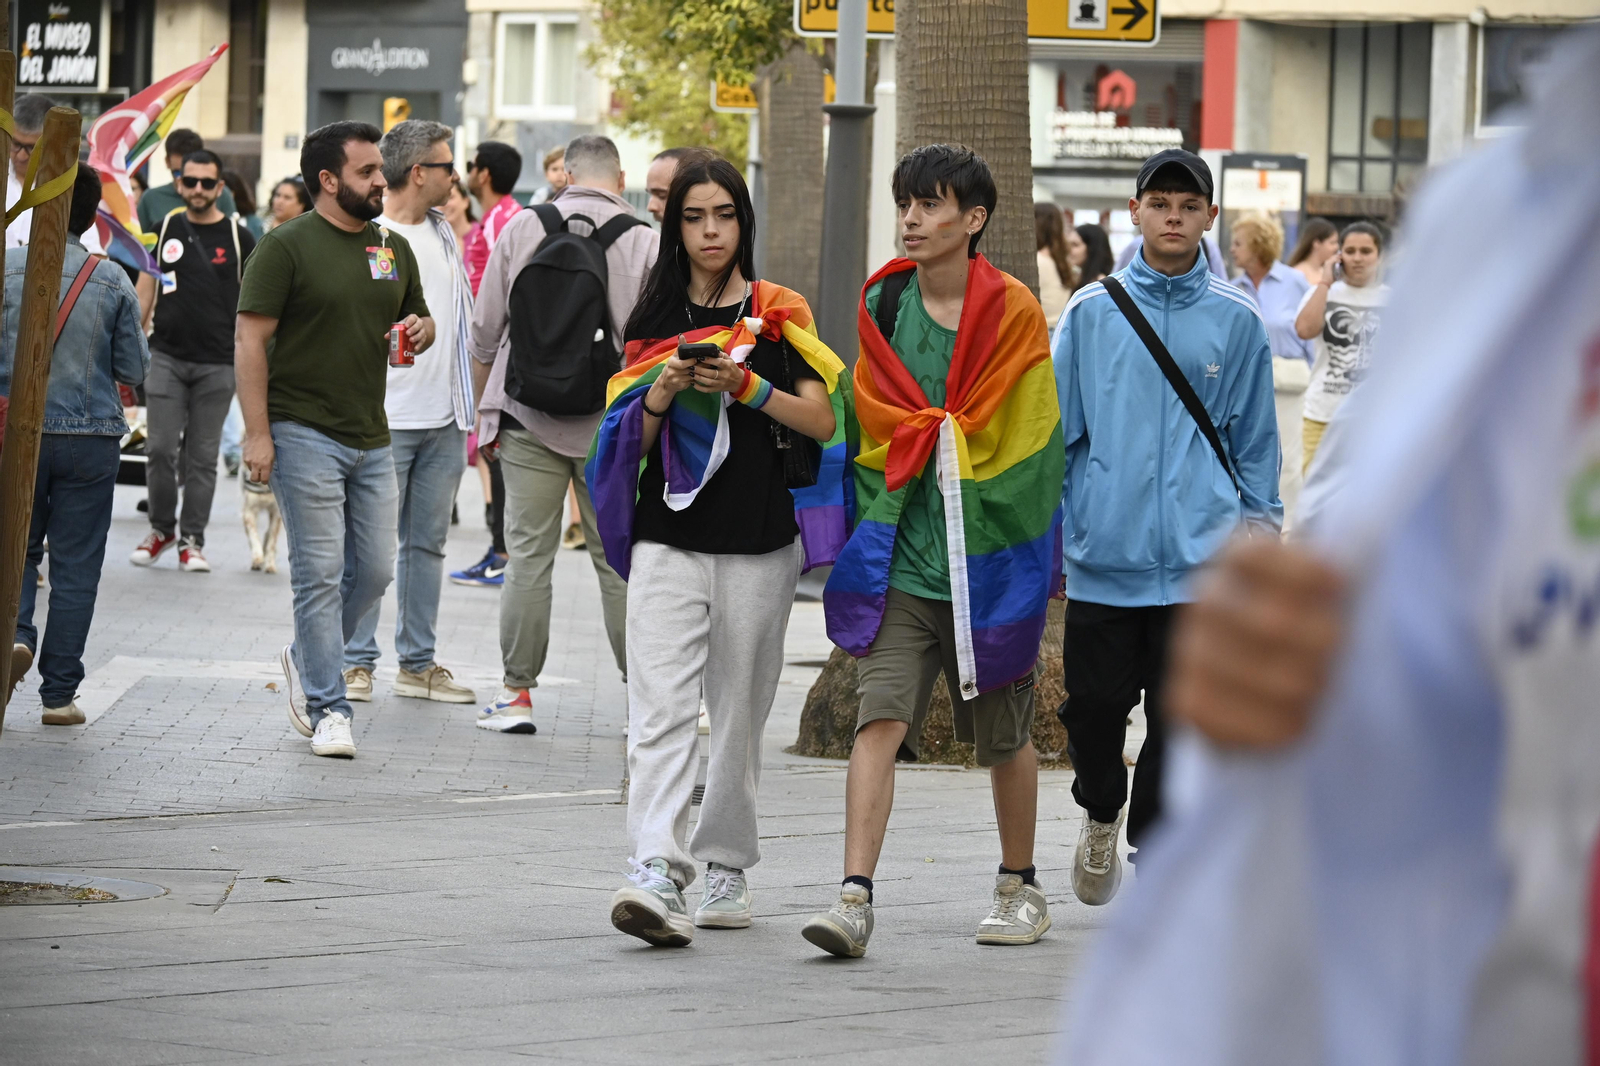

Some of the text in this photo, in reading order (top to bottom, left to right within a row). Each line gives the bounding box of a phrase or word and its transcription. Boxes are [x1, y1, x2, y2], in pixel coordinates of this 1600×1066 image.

[26, 21, 91, 56] EL MUSEO
[20, 55, 44, 84] DEL
